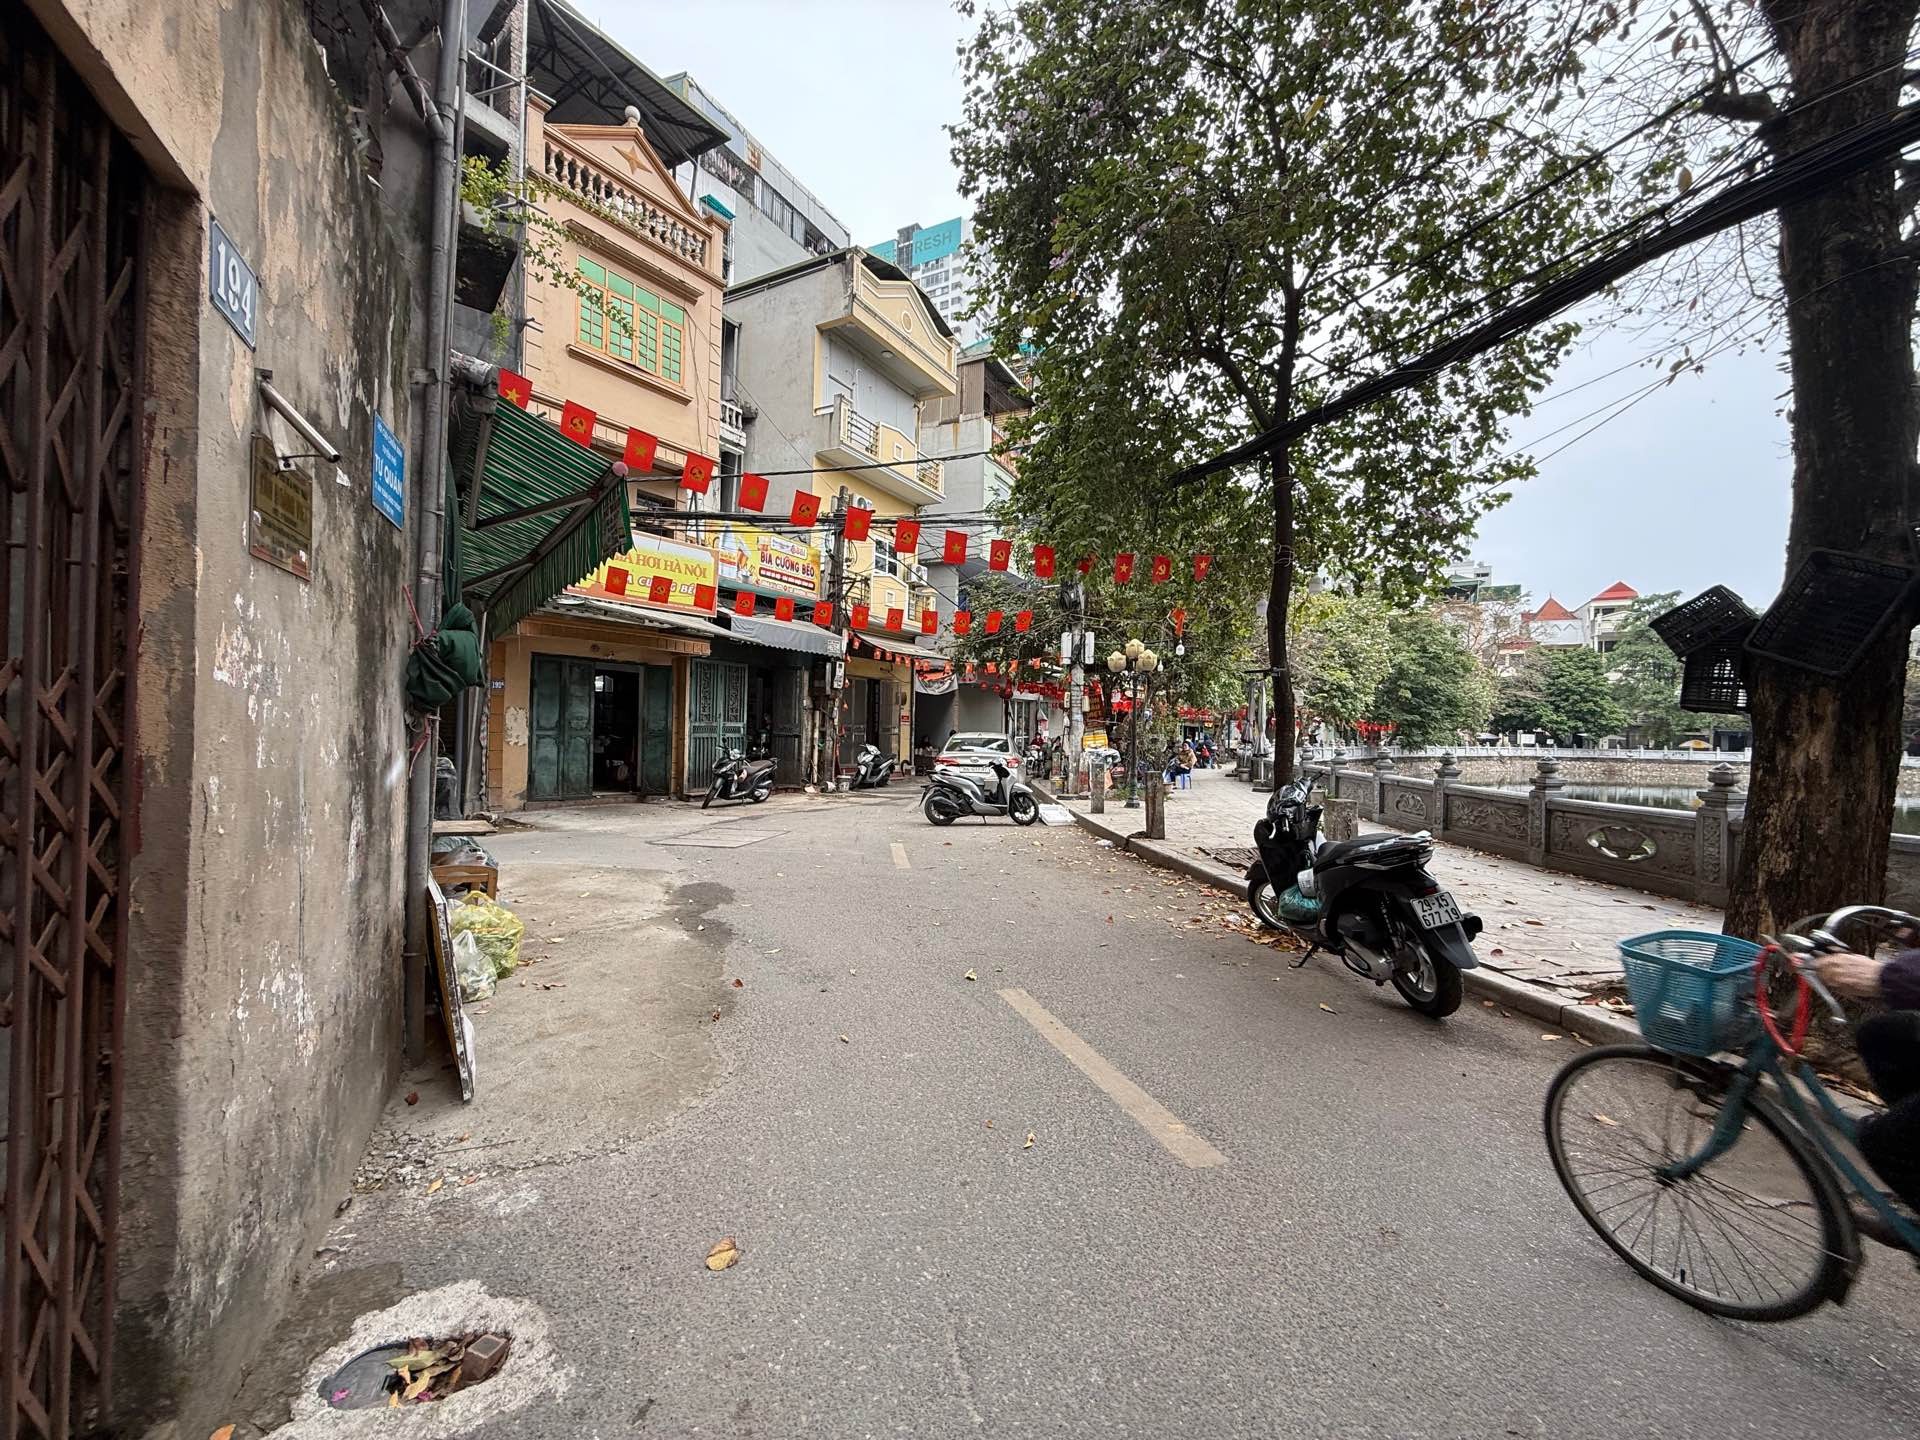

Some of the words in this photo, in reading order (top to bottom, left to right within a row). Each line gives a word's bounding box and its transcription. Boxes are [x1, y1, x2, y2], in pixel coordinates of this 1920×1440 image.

[217, 240, 252, 332] 194
[375, 453, 384, 481] TỰ
[384, 465, 403, 498] QUẢN
[760, 551, 773, 565] BIA
[663, 558, 682, 574] HÀ
[684, 563, 707, 580] NỘI
[1417, 894, 1450, 913] 29-X5
[1421, 907, 1460, 927] 677.19
